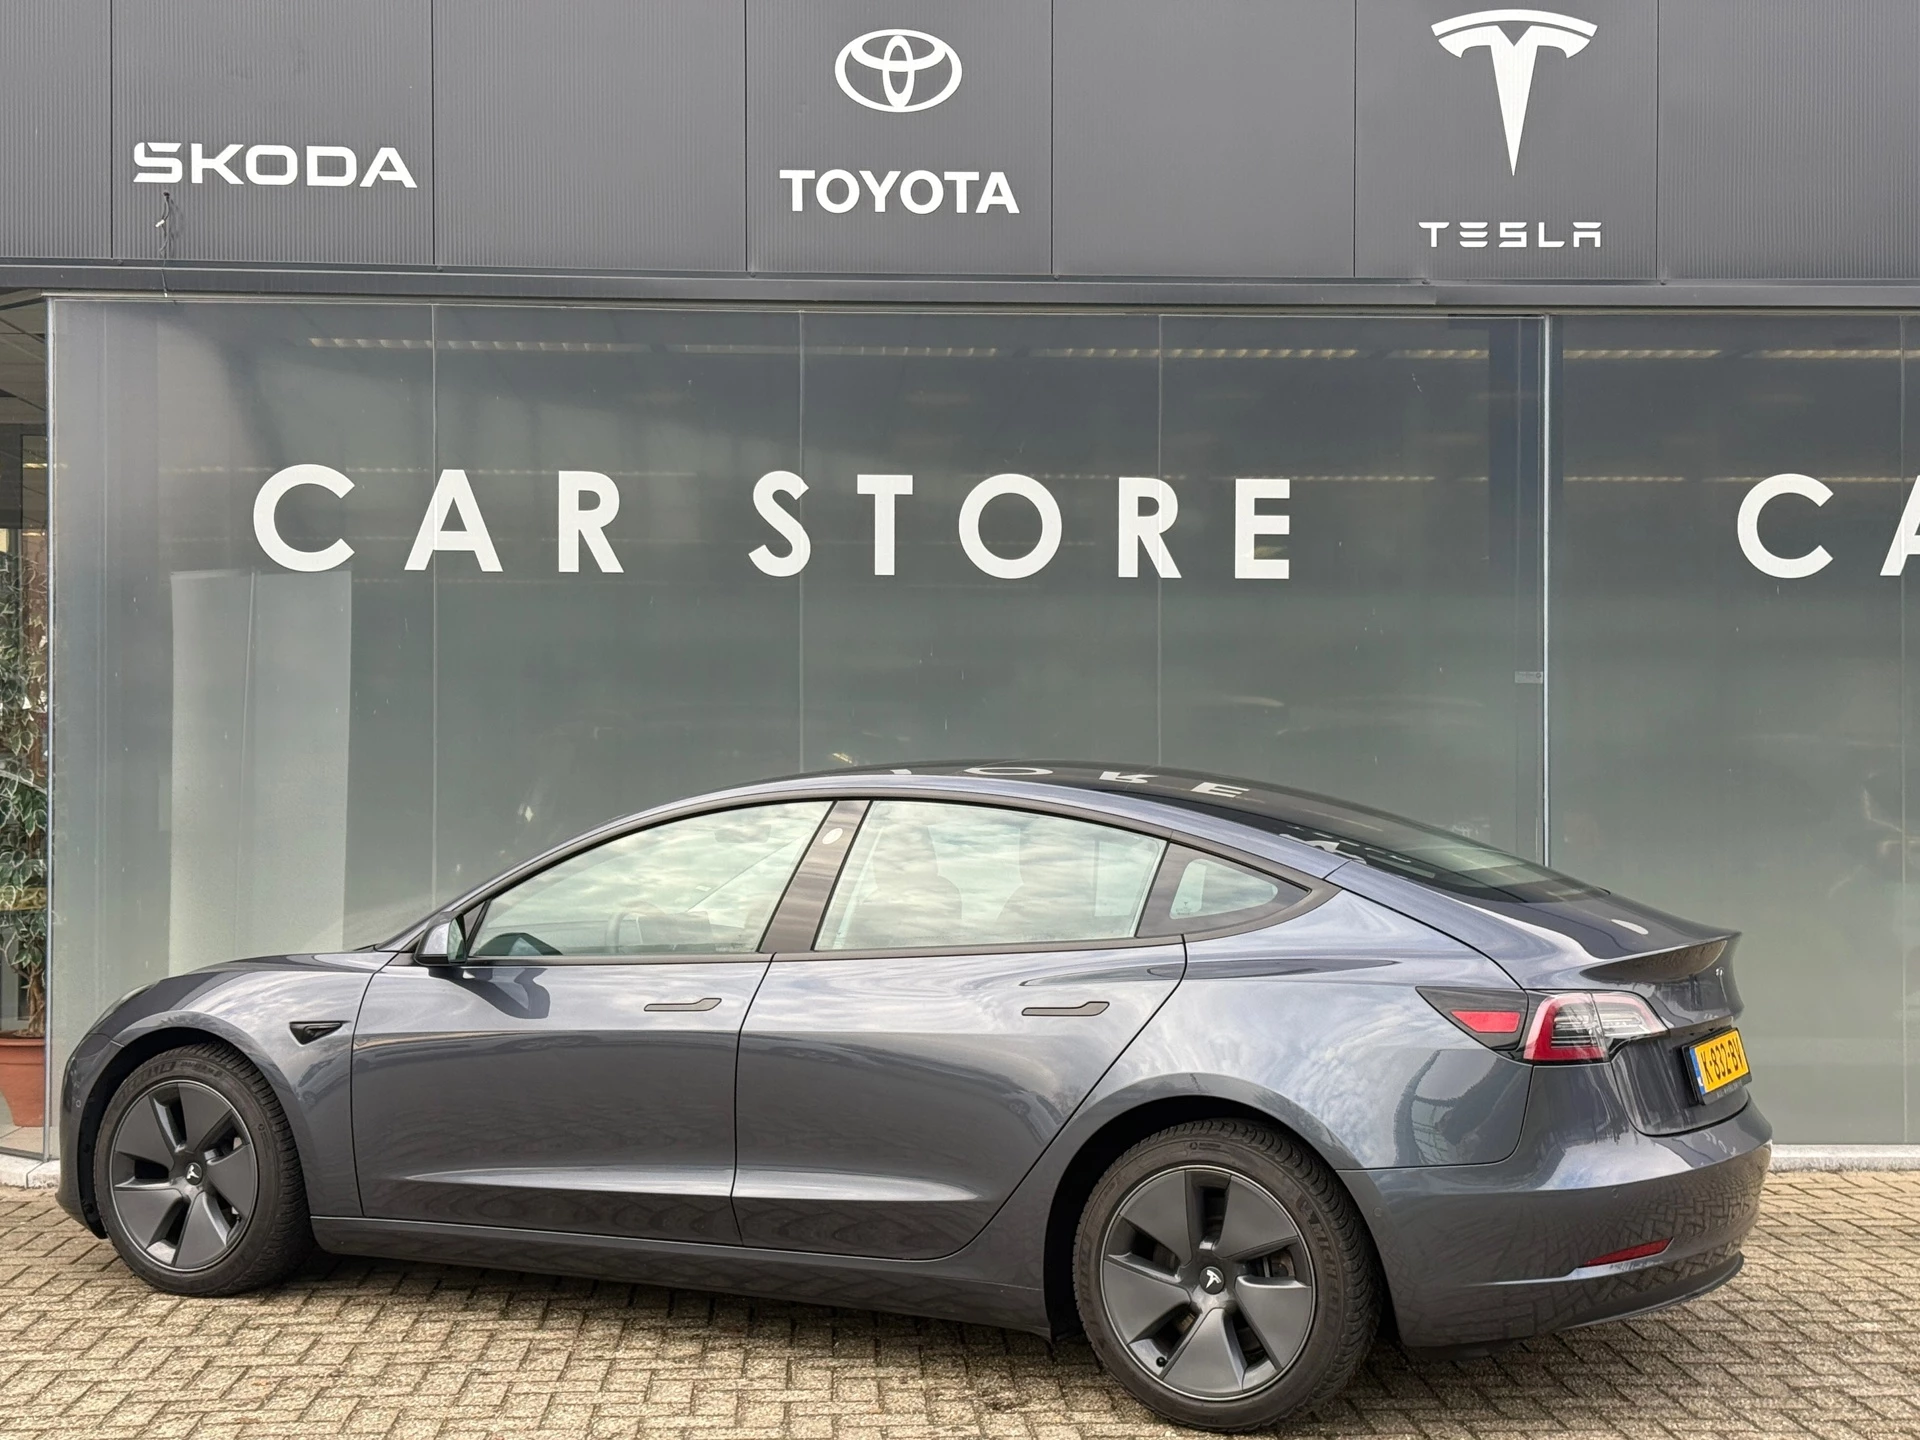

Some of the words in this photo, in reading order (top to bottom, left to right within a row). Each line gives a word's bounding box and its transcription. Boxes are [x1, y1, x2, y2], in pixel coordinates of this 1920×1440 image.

[779, 168, 1020, 214] TOYOTA
[1418, 221, 1602, 248] TESLA
[253, 463, 624, 573] CAR
[748, 470, 1290, 580] STORE
[1701, 1036, 1744, 1085] K-832-BV
